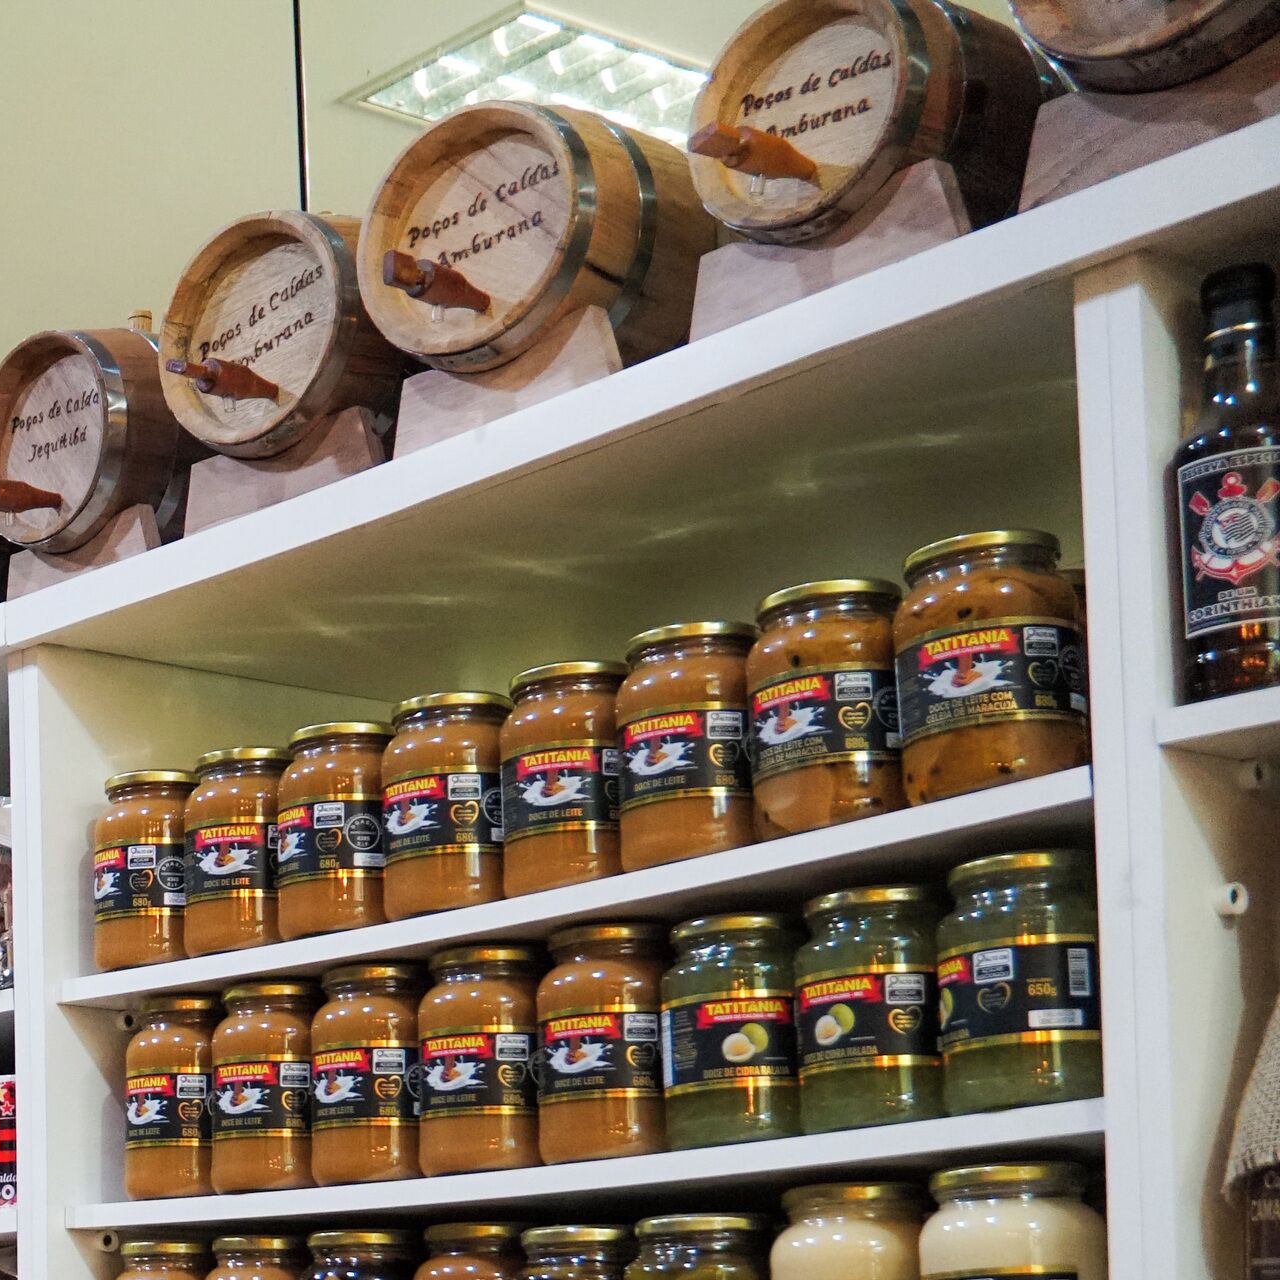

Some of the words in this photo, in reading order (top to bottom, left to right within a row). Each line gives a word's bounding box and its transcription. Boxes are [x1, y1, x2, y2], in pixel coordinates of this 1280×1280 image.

[742, 85, 792, 118] Poços
[800, 75, 821, 95] de
[829, 48, 892, 82] Caldas
[408, 213, 459, 248] Poços
[468, 194, 487, 218] de
[494, 161, 560, 201] Caldas
[438, 209, 544, 267] Amburana
[199, 324, 242, 361] Poços
[249, 304, 267, 327] de
[270, 264, 324, 312] Caldas
[235, 311, 314, 368] mburana
[12, 412, 43, 434] Poços
[49, 402, 63, 419] de
[66, 389, 100, 413] Calda
[28, 426, 88, 462] Jequitibá
[1181, 458, 1228, 482] RESERVA
[1218, 588, 1233, 599] DE
[1237, 586, 1257, 597] UM
[952, 698, 964, 710] DE
[967, 695, 990, 707] LEITE
[991, 691, 1013, 702] COM
[549, 809, 558, 818] DE
[560, 808, 583, 818] LEITE
[1028, 982, 1057, 997] 650g
